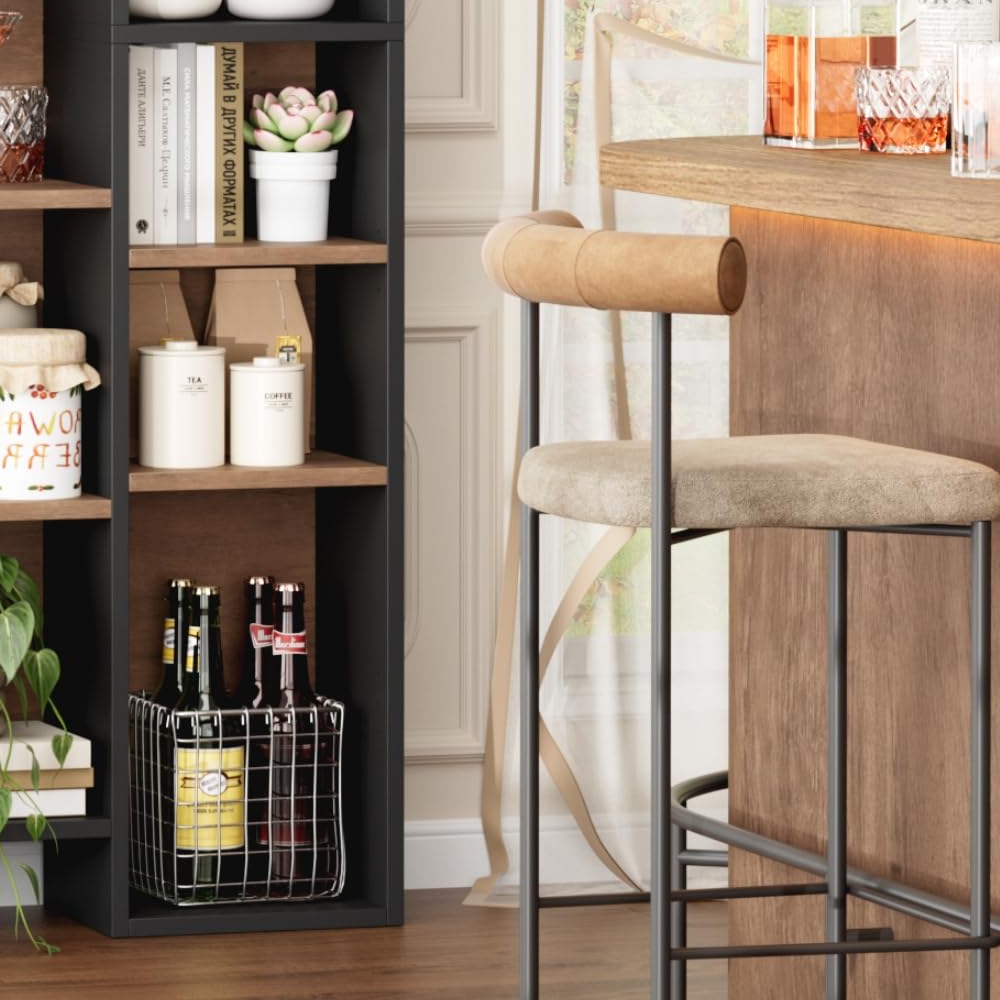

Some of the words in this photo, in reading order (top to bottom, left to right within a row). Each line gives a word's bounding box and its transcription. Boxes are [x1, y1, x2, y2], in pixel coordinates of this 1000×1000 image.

[221, 47, 239, 91] ДУМАЙ
[223, 95, 236, 103] В
[221, 107, 237, 155] ДРУГИХ
[223, 159, 237, 225] ФОРМАТАХ
[187, 376, 202, 384] TEA
[264, 392, 293, 400] COFFEE
